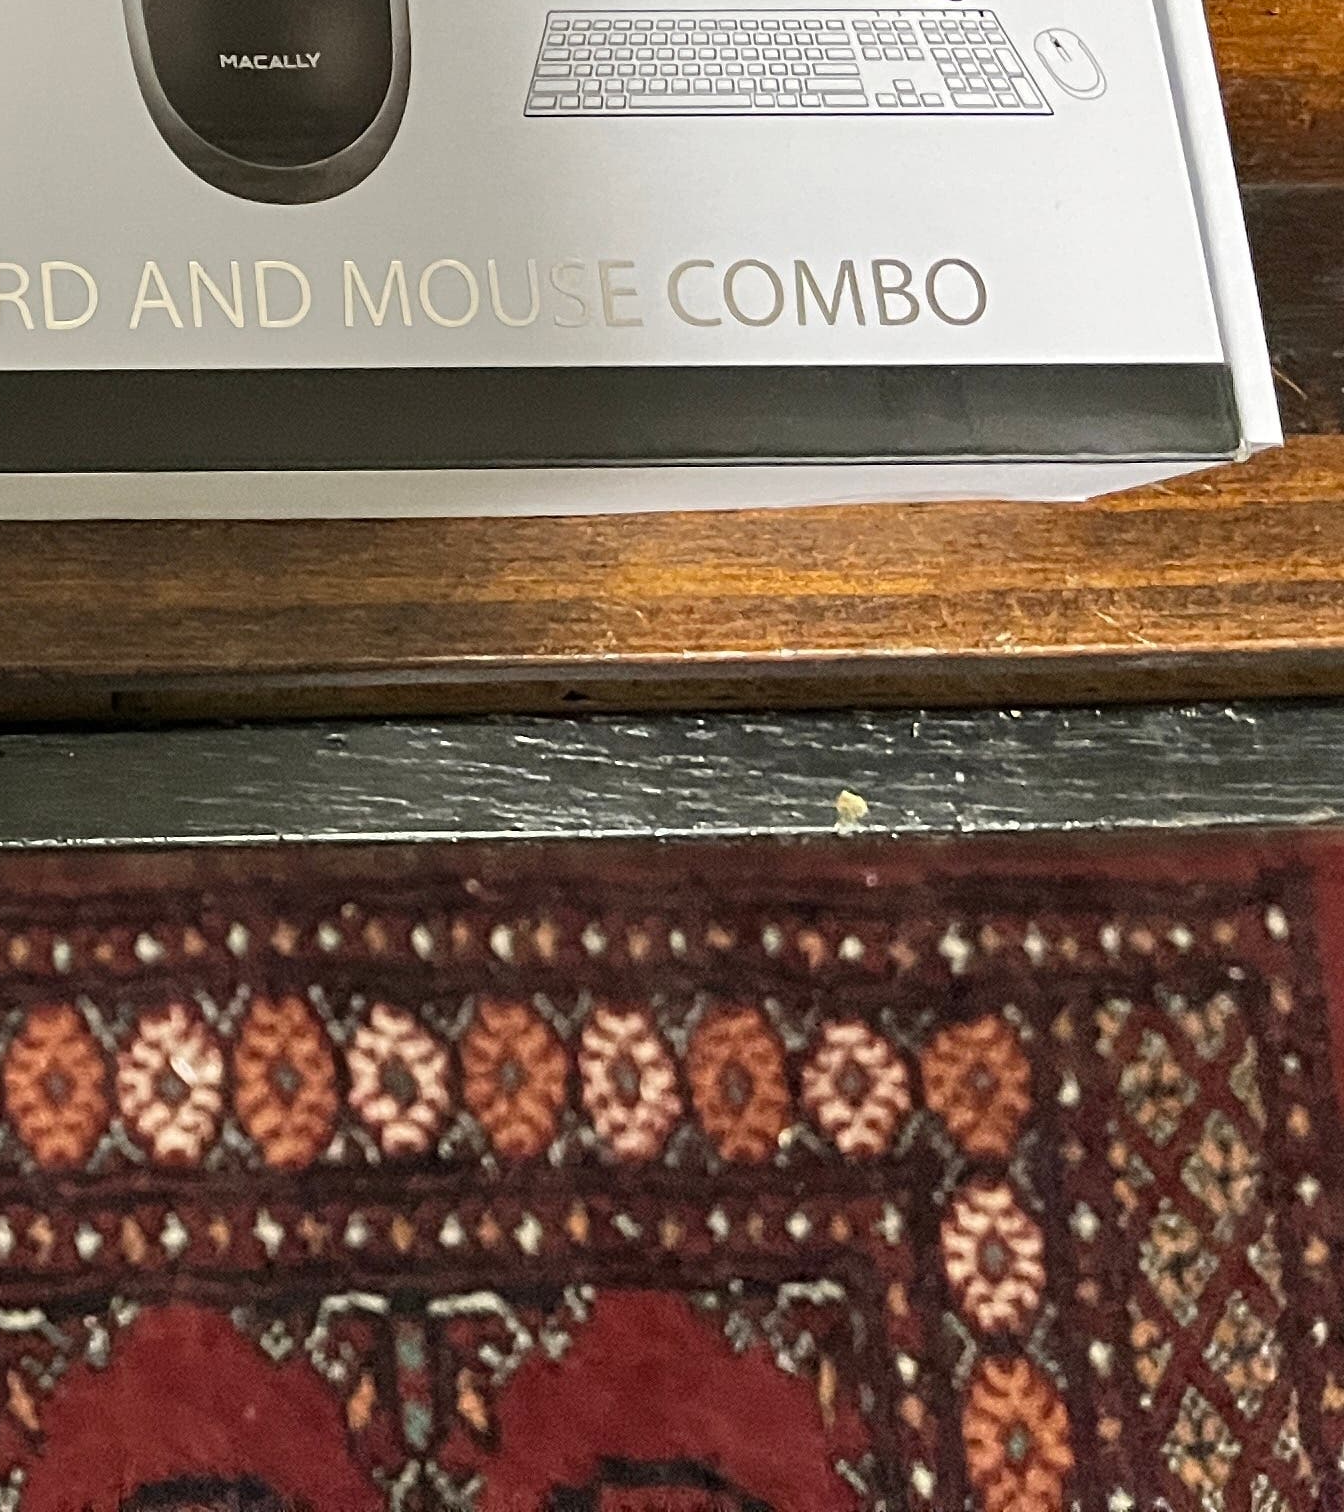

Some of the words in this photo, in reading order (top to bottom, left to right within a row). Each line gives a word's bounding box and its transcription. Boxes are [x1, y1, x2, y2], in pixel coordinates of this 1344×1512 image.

[219, 52, 321, 70] MACALLY
[129, 260, 312, 329] AND
[343, 258, 644, 328] MOUSE
[667, 258, 987, 326] COMBO
